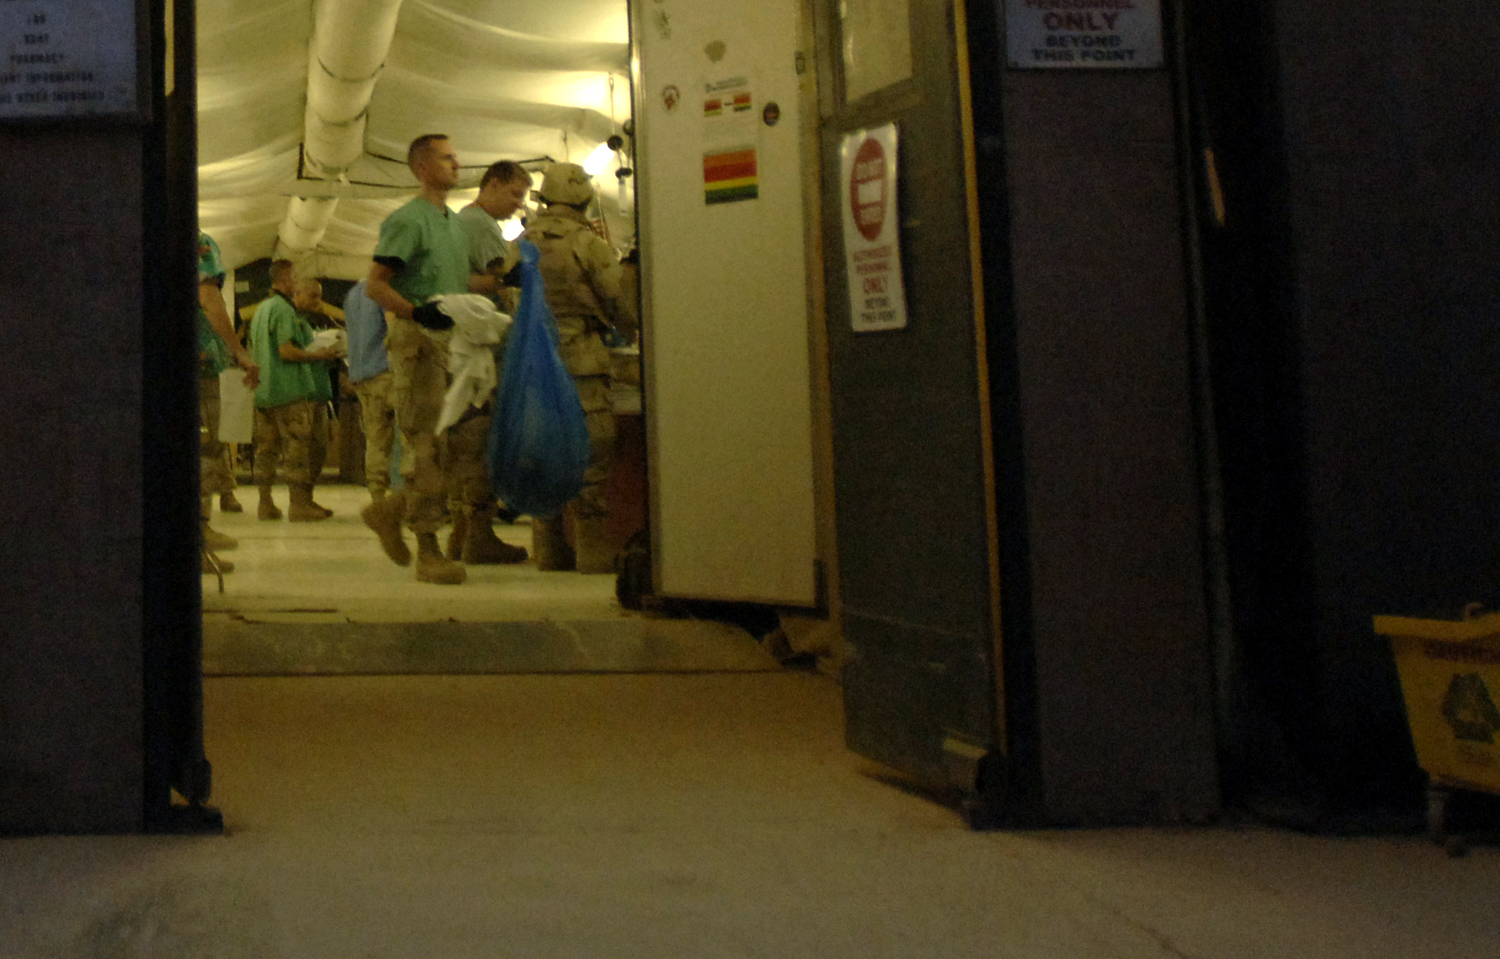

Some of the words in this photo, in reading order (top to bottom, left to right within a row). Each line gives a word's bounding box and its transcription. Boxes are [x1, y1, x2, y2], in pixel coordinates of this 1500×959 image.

[1043, 12, 1119, 30] ONLY
[1045, 35, 1122, 47] BEYOND
[1032, 49, 1074, 61] THIS
[1081, 49, 1135, 61] POINT
